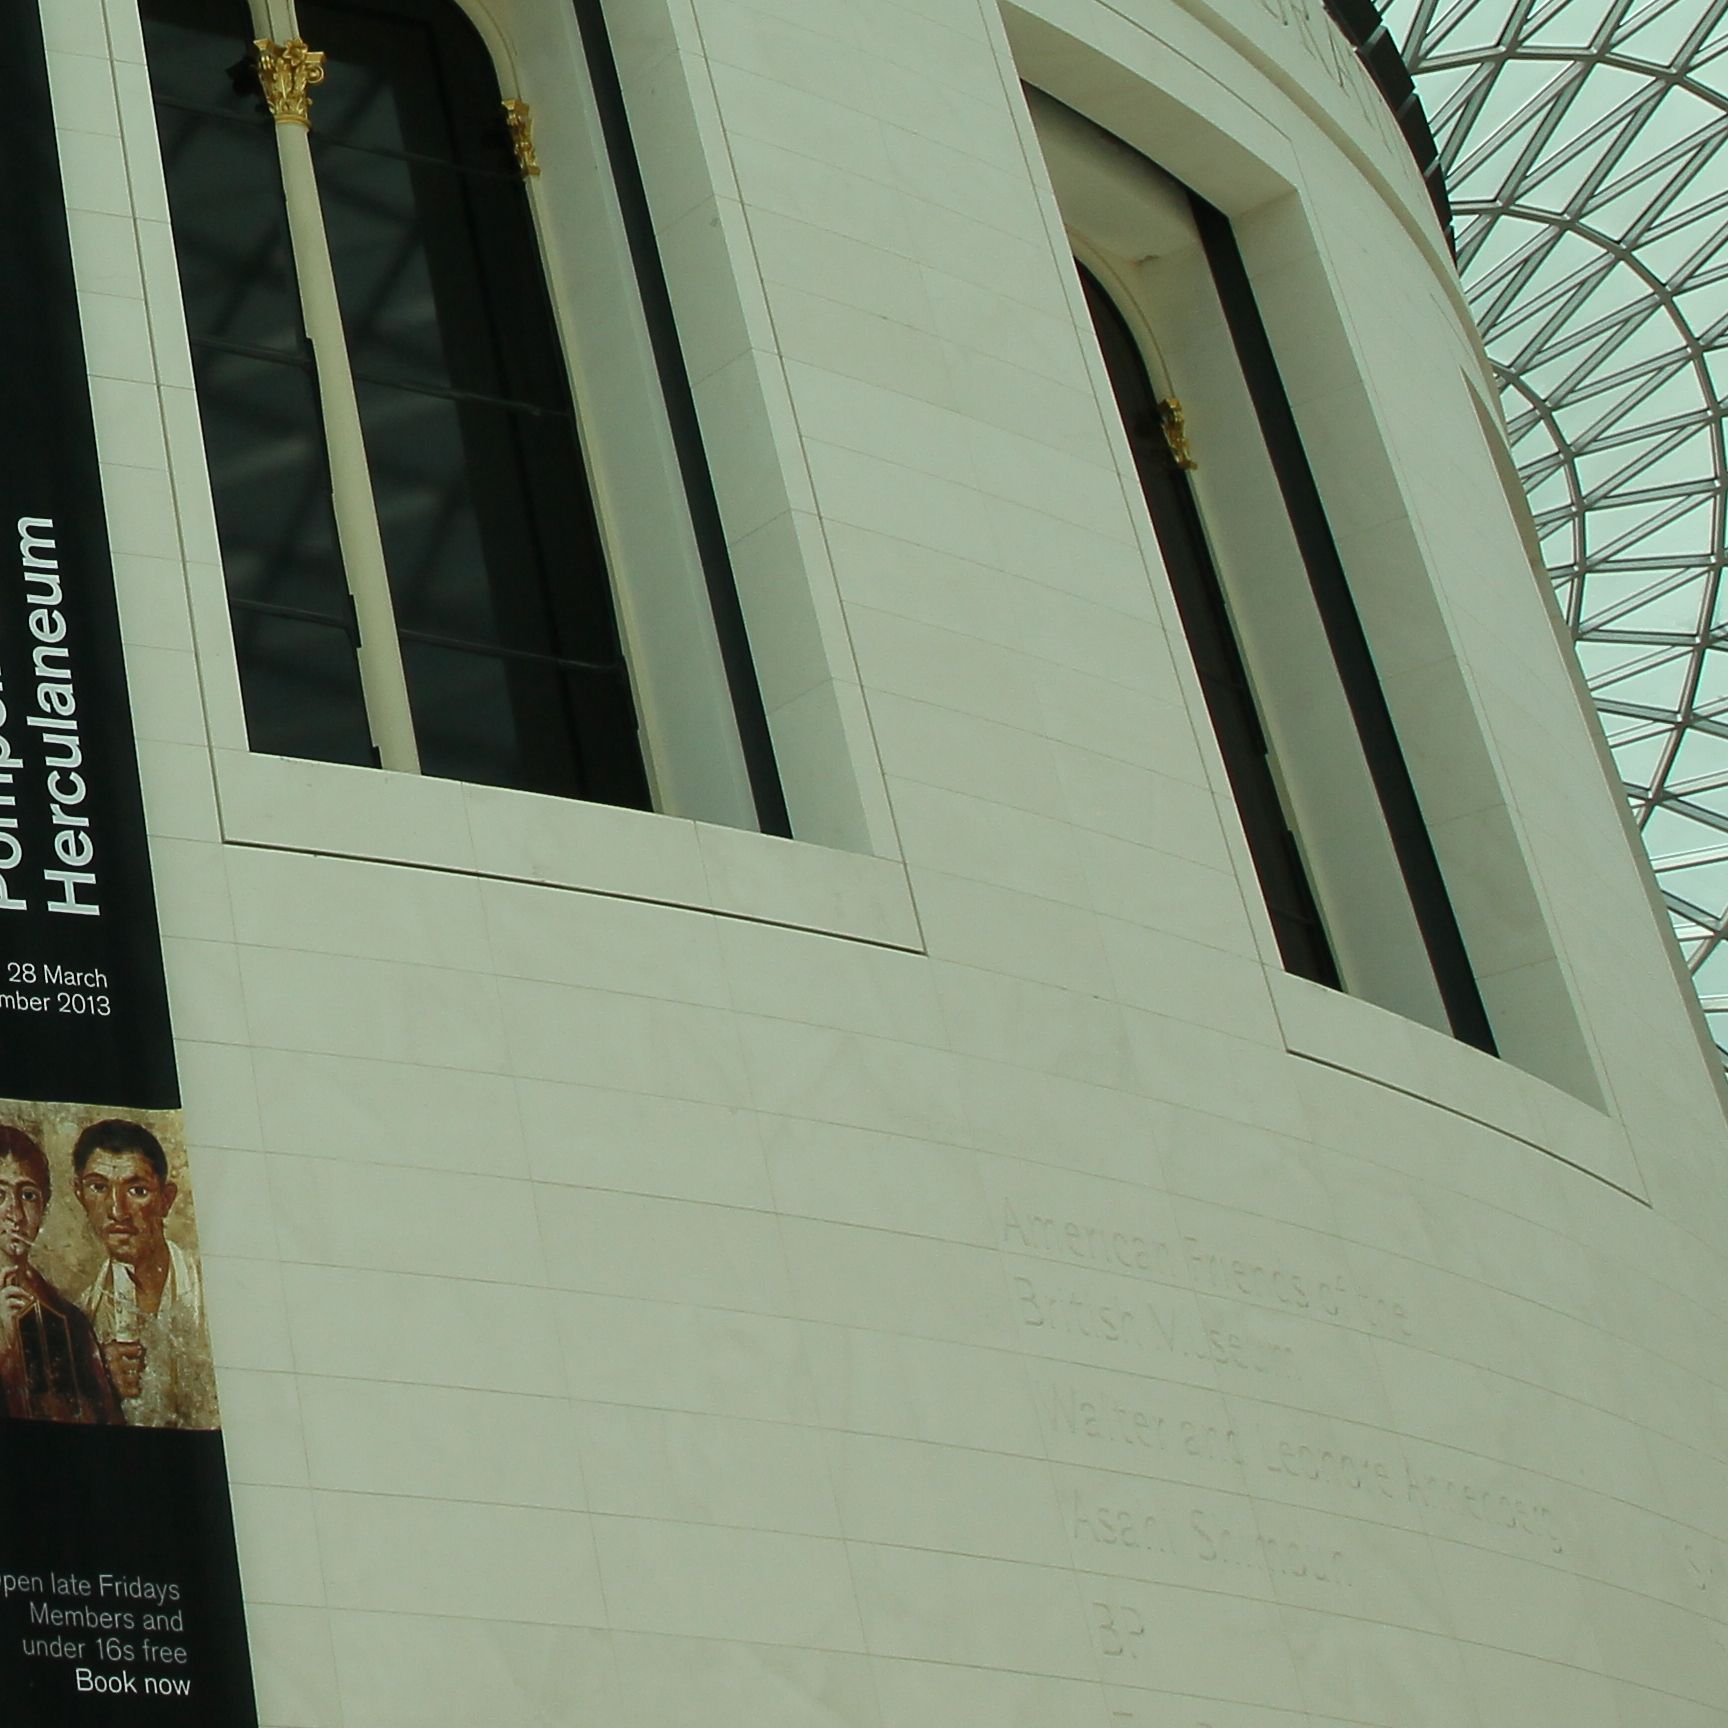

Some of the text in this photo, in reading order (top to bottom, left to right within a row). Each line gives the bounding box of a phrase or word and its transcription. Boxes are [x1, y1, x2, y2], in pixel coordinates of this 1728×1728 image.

[16, 516, 101, 917] Herculaneum
[7, 961, 108, 989] 28 March
[56, 991, 111, 1017] 2013
[50, 1571, 92, 1596] late
[98, 1573, 180, 1607] Fridays
[29, 1601, 184, 1632] Members and
[22, 1635, 188, 1664] under 16s free
[75, 1667, 191, 1696] Book now
